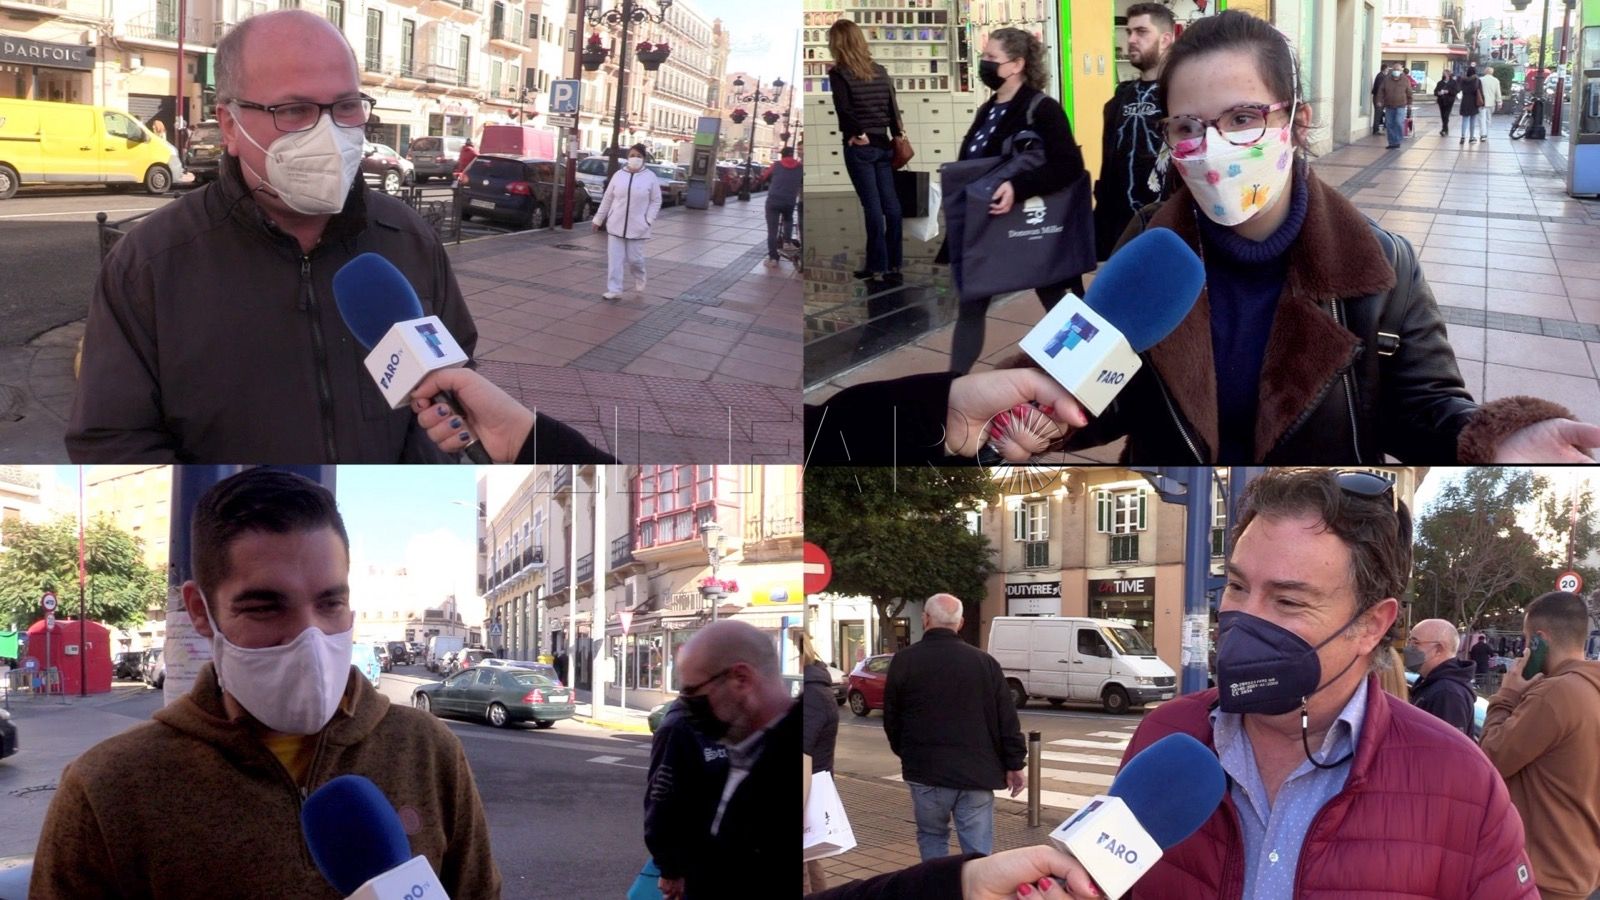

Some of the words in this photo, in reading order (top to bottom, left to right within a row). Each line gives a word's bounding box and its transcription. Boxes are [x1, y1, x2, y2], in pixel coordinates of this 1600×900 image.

[554, 84, 573, 110] P
[1007, 584, 1053, 596] DUTYFREE
[1561, 580, 1576, 589] 20
[1096, 831, 1138, 864] FARO
